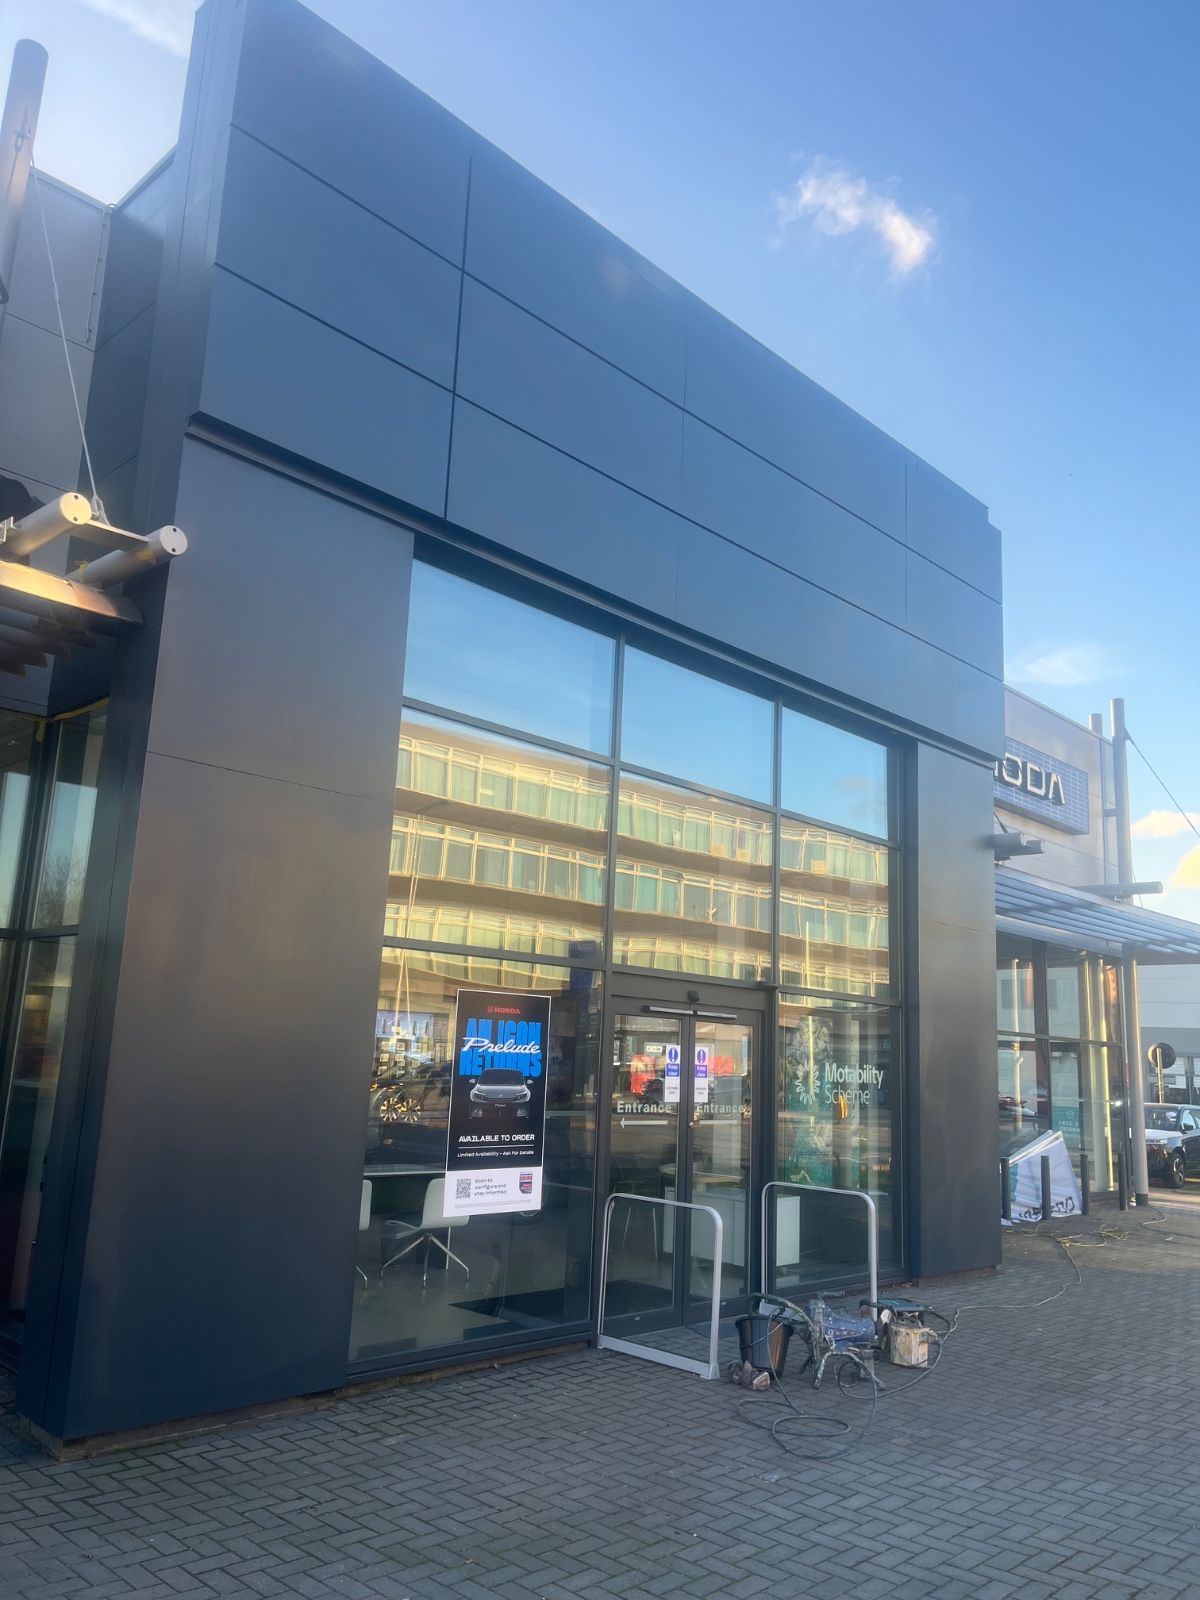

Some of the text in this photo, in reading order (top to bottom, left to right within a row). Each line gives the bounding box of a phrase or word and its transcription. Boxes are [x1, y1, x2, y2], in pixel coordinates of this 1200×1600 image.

[994, 752, 1066, 805] ODA
[464, 1018, 541, 1047] AN ICON
[462, 1037, 541, 1054] Prelude
[459, 1046, 542, 1077] RETURNS
[825, 1062, 883, 1089] Motability
[825, 1085, 870, 1104] Scheme
[617, 1101, 672, 1113] Entrance
[697, 1102, 744, 1113] Entrance
